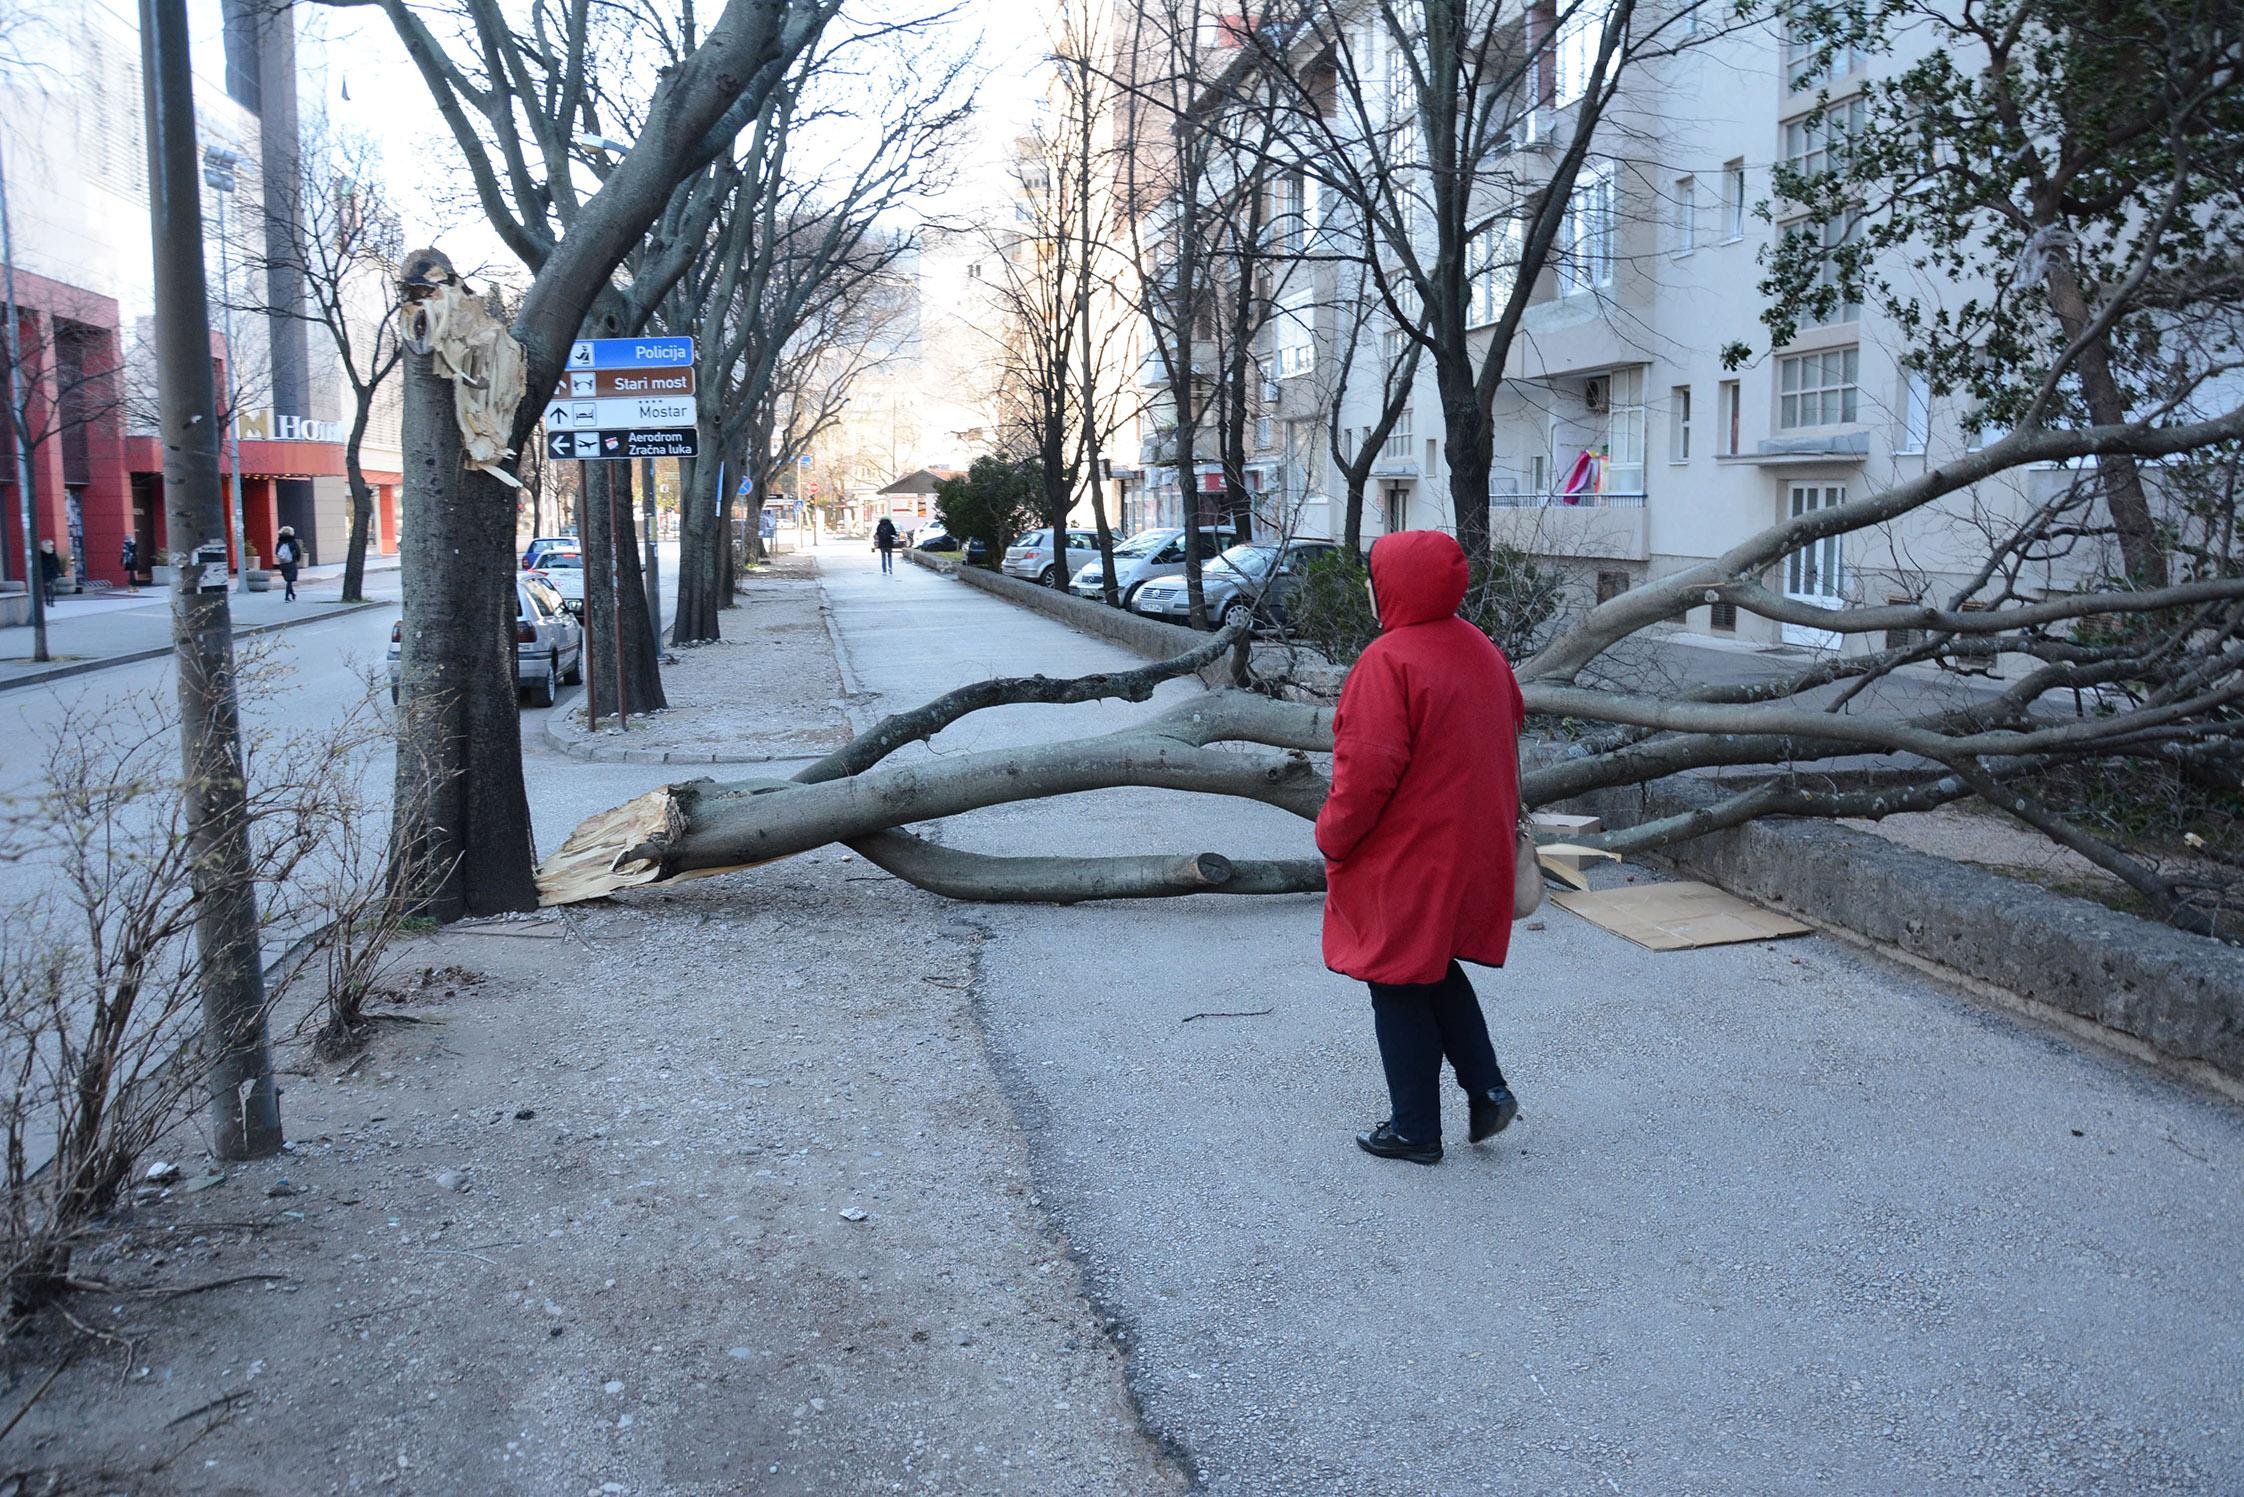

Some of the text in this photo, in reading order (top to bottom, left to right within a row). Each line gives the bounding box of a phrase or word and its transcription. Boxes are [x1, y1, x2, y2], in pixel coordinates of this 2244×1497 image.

[636, 345, 686, 361] Policija
[614, 376, 687, 391] Stari most
[639, 405, 687, 418] Mostar
[277, 414, 345, 442] HOTE
[628, 432, 683, 443] Aerodrom
[628, 443, 692, 456] Zračna luka
